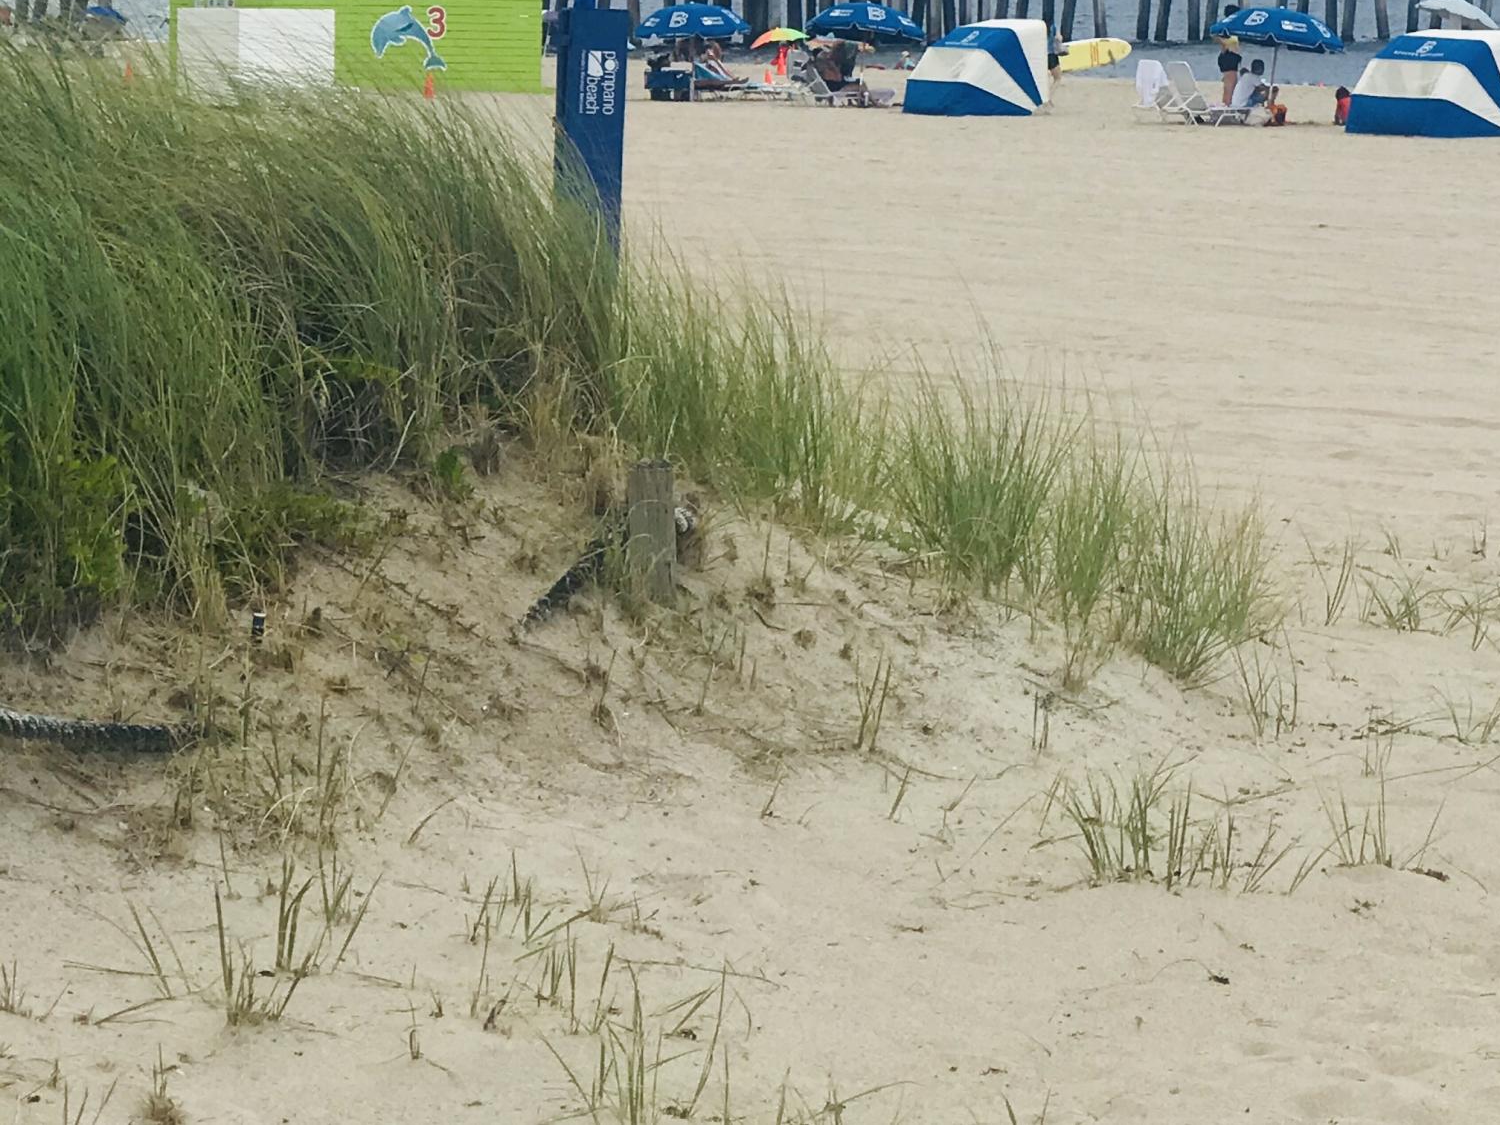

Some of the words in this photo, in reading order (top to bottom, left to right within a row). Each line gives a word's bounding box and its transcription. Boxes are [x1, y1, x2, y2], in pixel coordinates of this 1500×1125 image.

[426, 5, 447, 39] 3
[669, 11, 689, 28] B
[1244, 11, 1269, 26] B
[585, 76, 601, 114] beach
[601, 51, 618, 115] pompano
